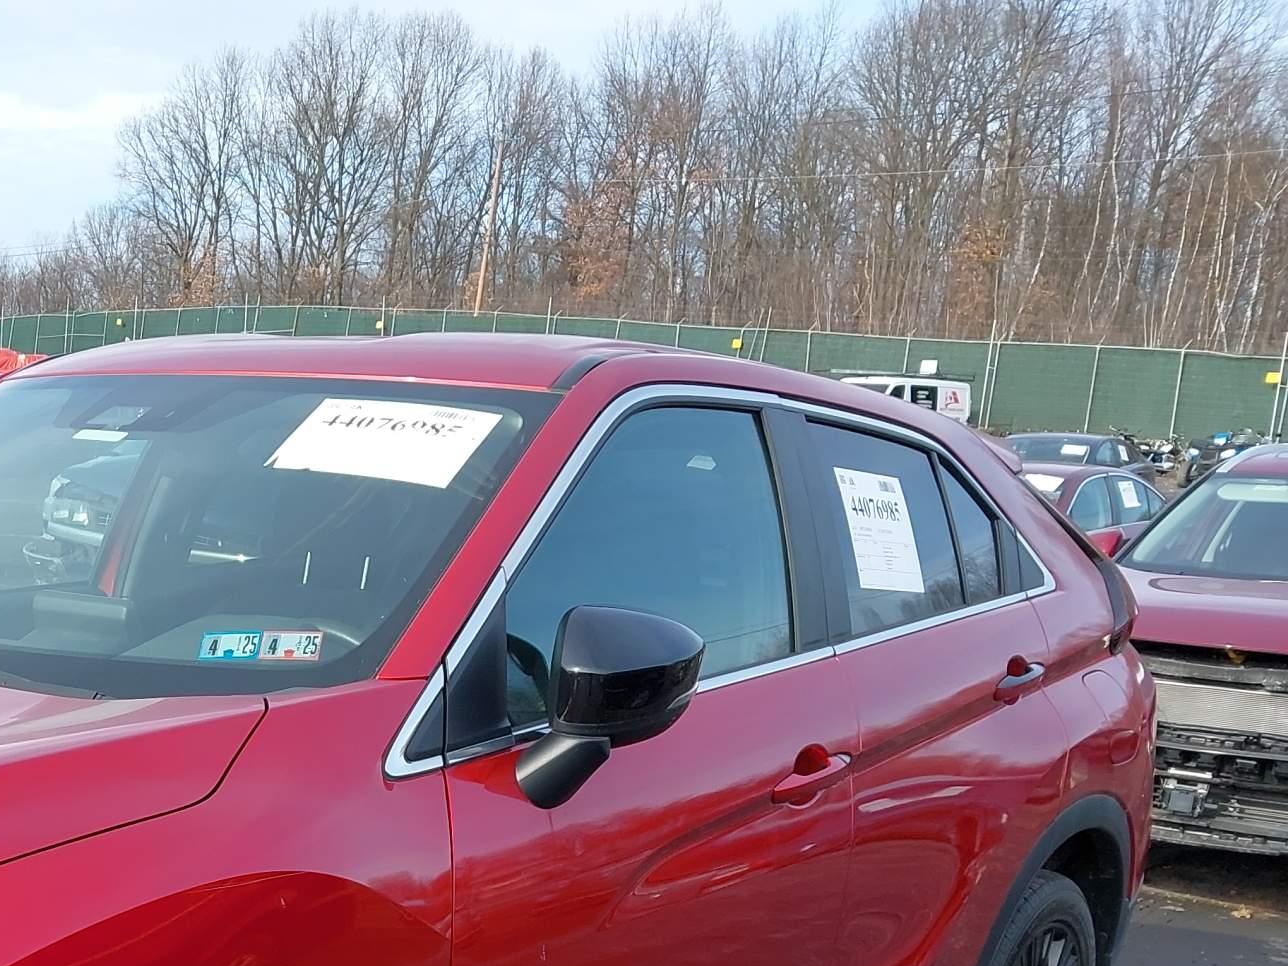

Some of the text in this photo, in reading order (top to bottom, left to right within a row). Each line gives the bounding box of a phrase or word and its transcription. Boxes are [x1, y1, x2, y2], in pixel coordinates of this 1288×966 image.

[208, 639, 219, 656] 4
[242, 635, 258, 655] 25
[268, 638, 279, 656] 4
[303, 635, 319, 655] 25
